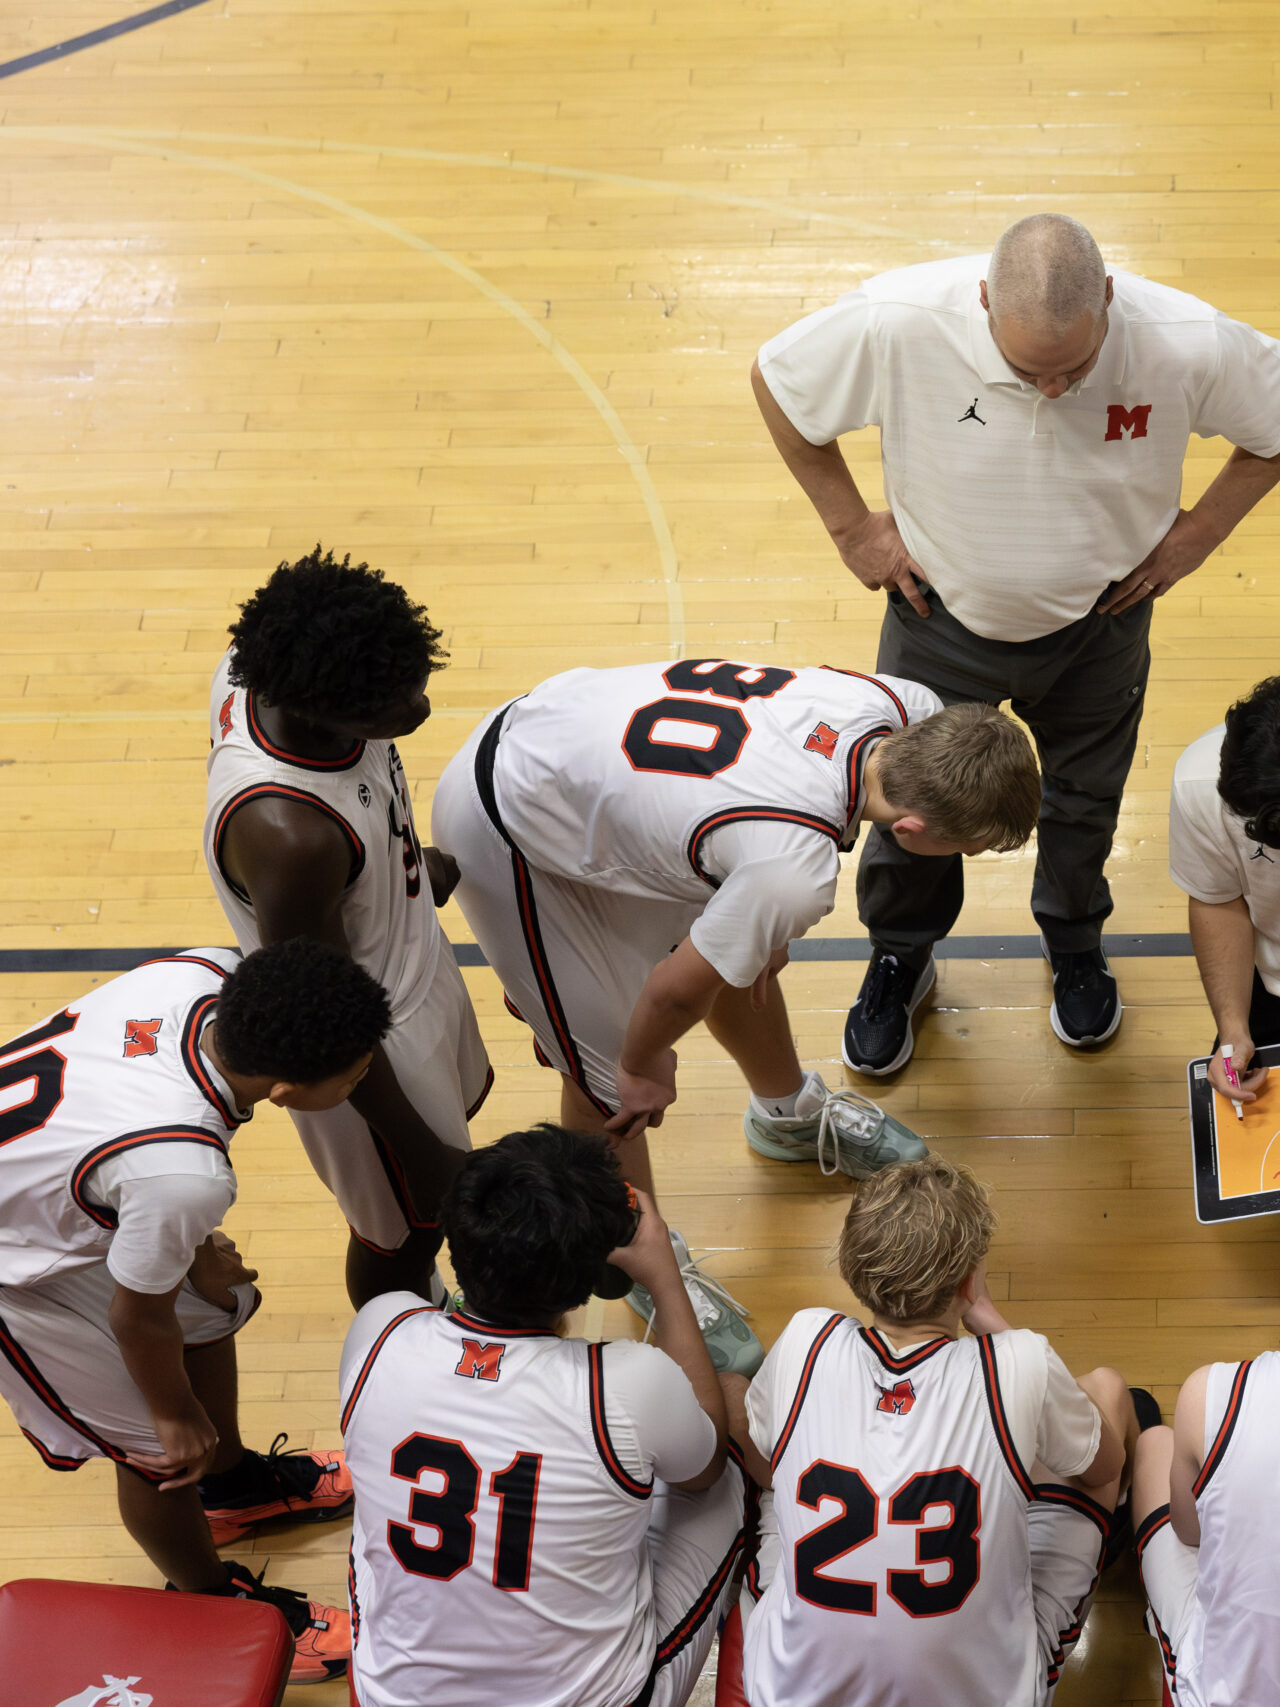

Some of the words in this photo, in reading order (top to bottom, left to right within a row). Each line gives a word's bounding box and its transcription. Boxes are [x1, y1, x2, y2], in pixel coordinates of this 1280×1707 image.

[1104, 404, 1152, 442] M
[621, 659, 797, 779] 30
[803, 721, 840, 760] M
[123, 1018, 163, 1058] M
[454, 1338, 506, 1382] M
[876, 1378, 916, 1415] M
[387, 1431, 542, 1592] 31
[794, 1458, 981, 1619] 23
